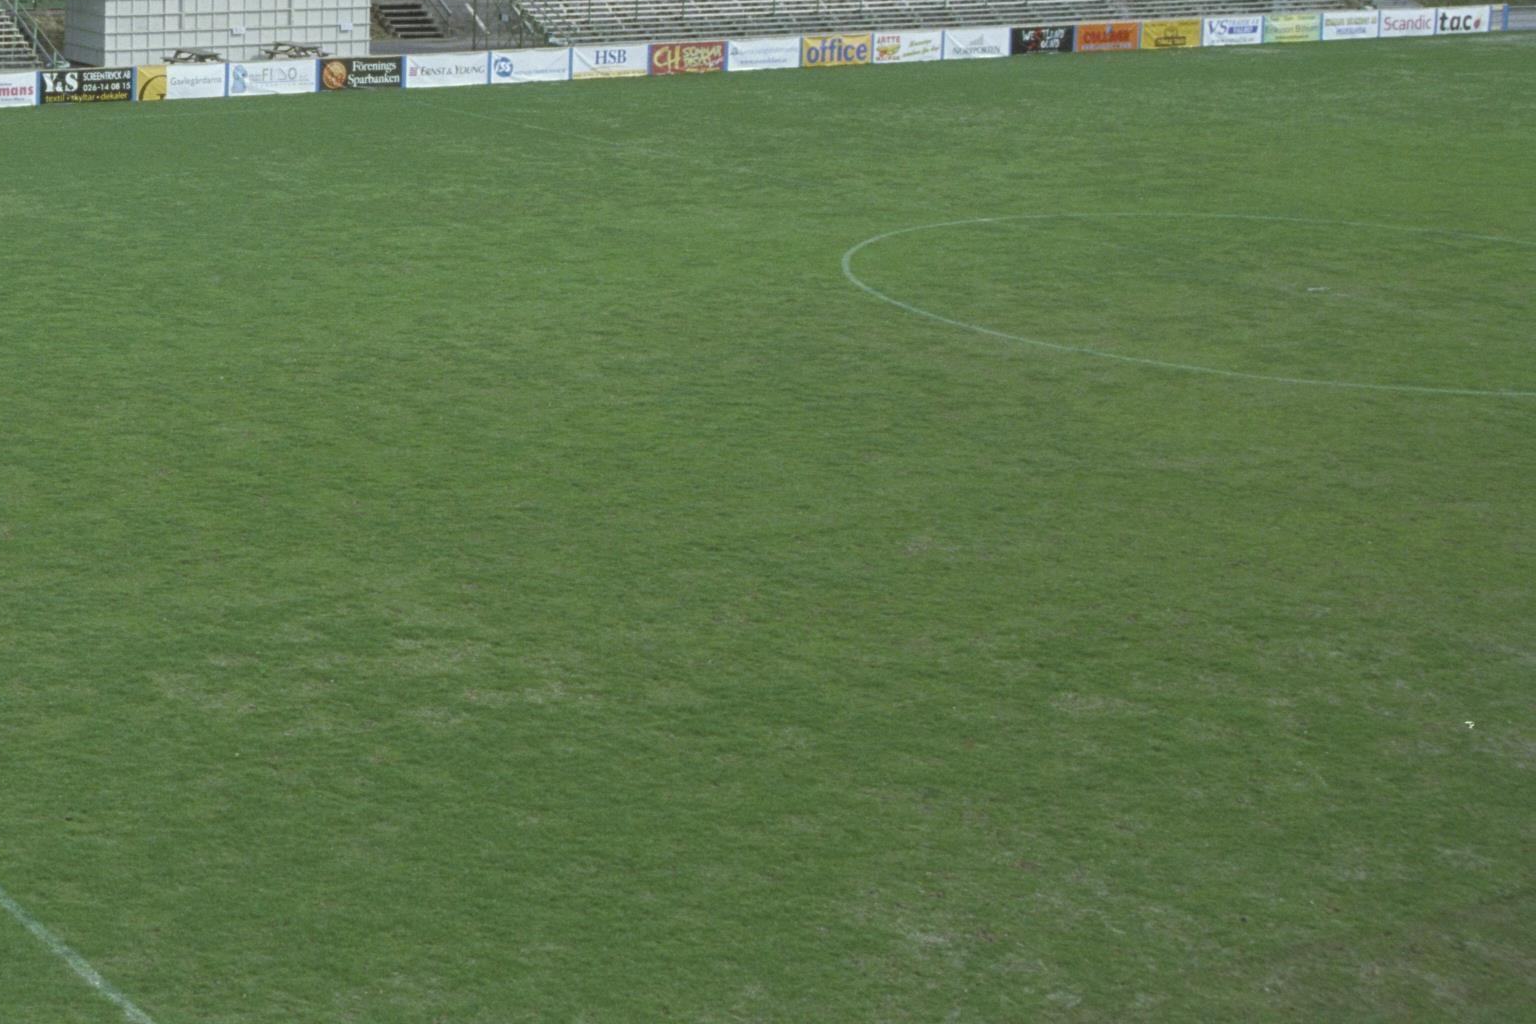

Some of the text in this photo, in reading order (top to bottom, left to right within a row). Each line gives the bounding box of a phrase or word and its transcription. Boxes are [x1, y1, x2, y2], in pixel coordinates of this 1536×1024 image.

[1384, 15, 1432, 31] Scandic
[595, 49, 627, 65] HSB
[806, 37, 867, 65] office
[352, 60, 396, 72] Förenings
[420, 65, 446, 75] ERNST
[454, 63, 485, 74] YOUNG
[83, 70, 131, 82] SCREENTRYCK AB
[347, 73, 400, 86] Sparbanken
[83, 83, 109, 91] 026-14
